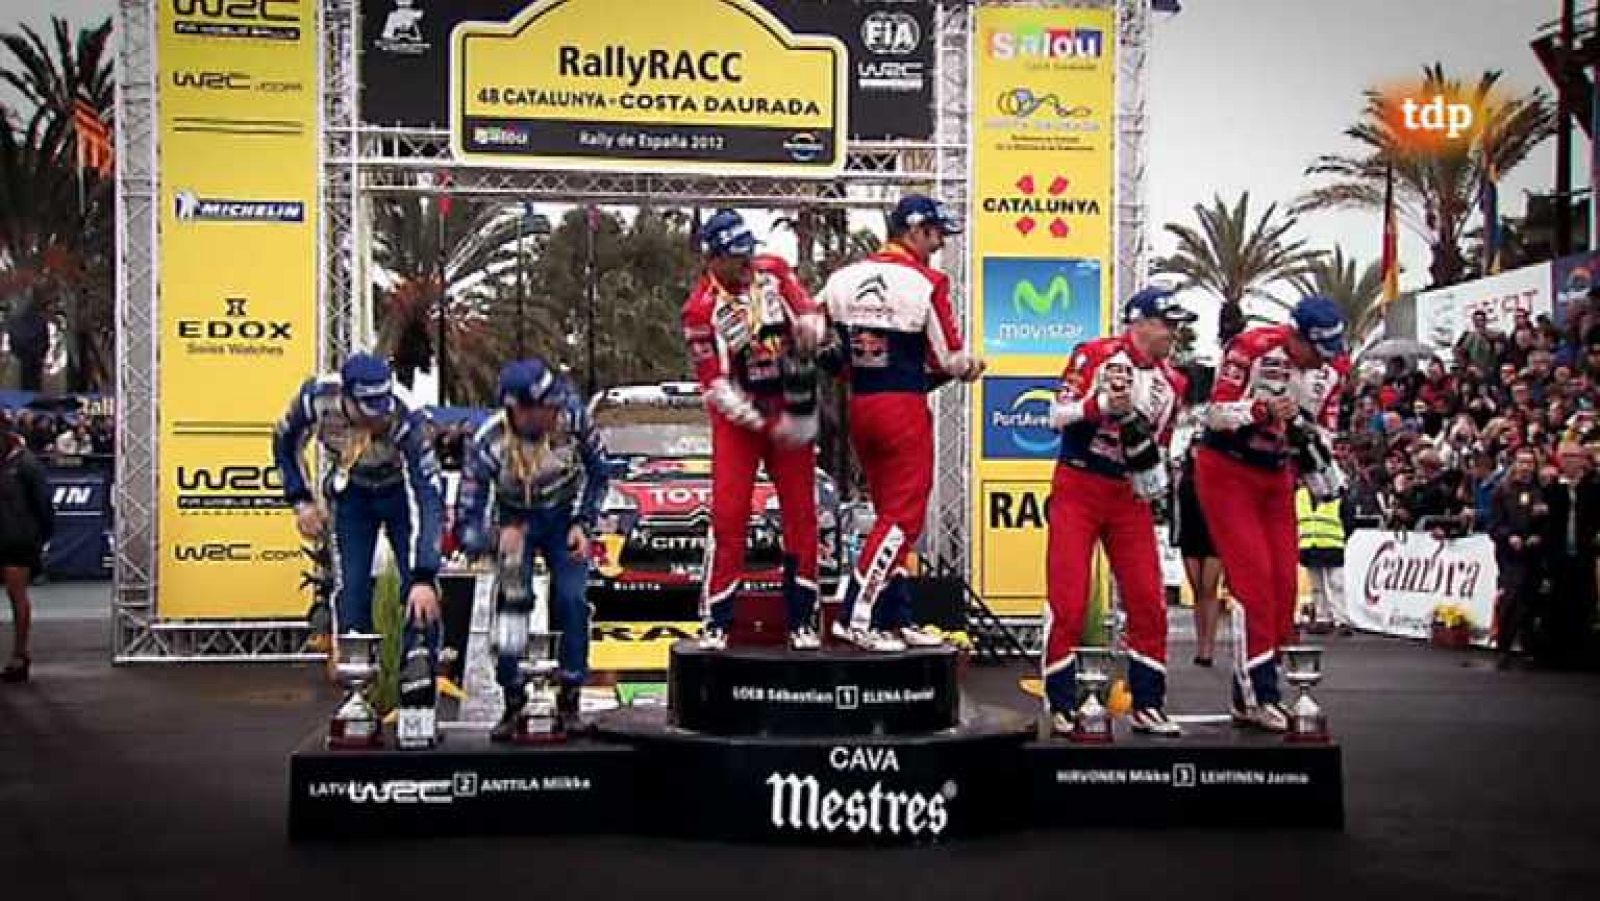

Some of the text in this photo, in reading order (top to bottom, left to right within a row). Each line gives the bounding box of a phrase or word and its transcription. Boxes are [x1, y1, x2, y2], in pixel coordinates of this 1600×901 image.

[867, 20, 913, 45] FIA
[991, 31, 1101, 58] Salou
[558, 45, 743, 87] RallyRACC
[858, 62, 924, 78] WRC
[503, 90, 605, 108] CATALUNYA
[619, 93, 697, 113] COSTA
[703, 97, 821, 117] DAURADA
[579, 131, 724, 150] Rally de España 2012
[201, 203, 301, 217] MICHELIN
[983, 197, 1101, 216] CATALUNYA
[177, 320, 293, 340] EDOX
[1000, 322, 1084, 341] movistar
[230, 343, 285, 356] Watches
[653, 488, 713, 501] TOT
[989, 491, 1051, 529] RA
[829, 746, 899, 771] CAVA
[481, 778, 539, 792] ANTTILA
[1056, 769, 1127, 784] HIRVONEN
[1130, 769, 1170, 783] Mikko
[1201, 771, 1264, 785] LEHTINEN
[766, 771, 948, 834] Mestres
